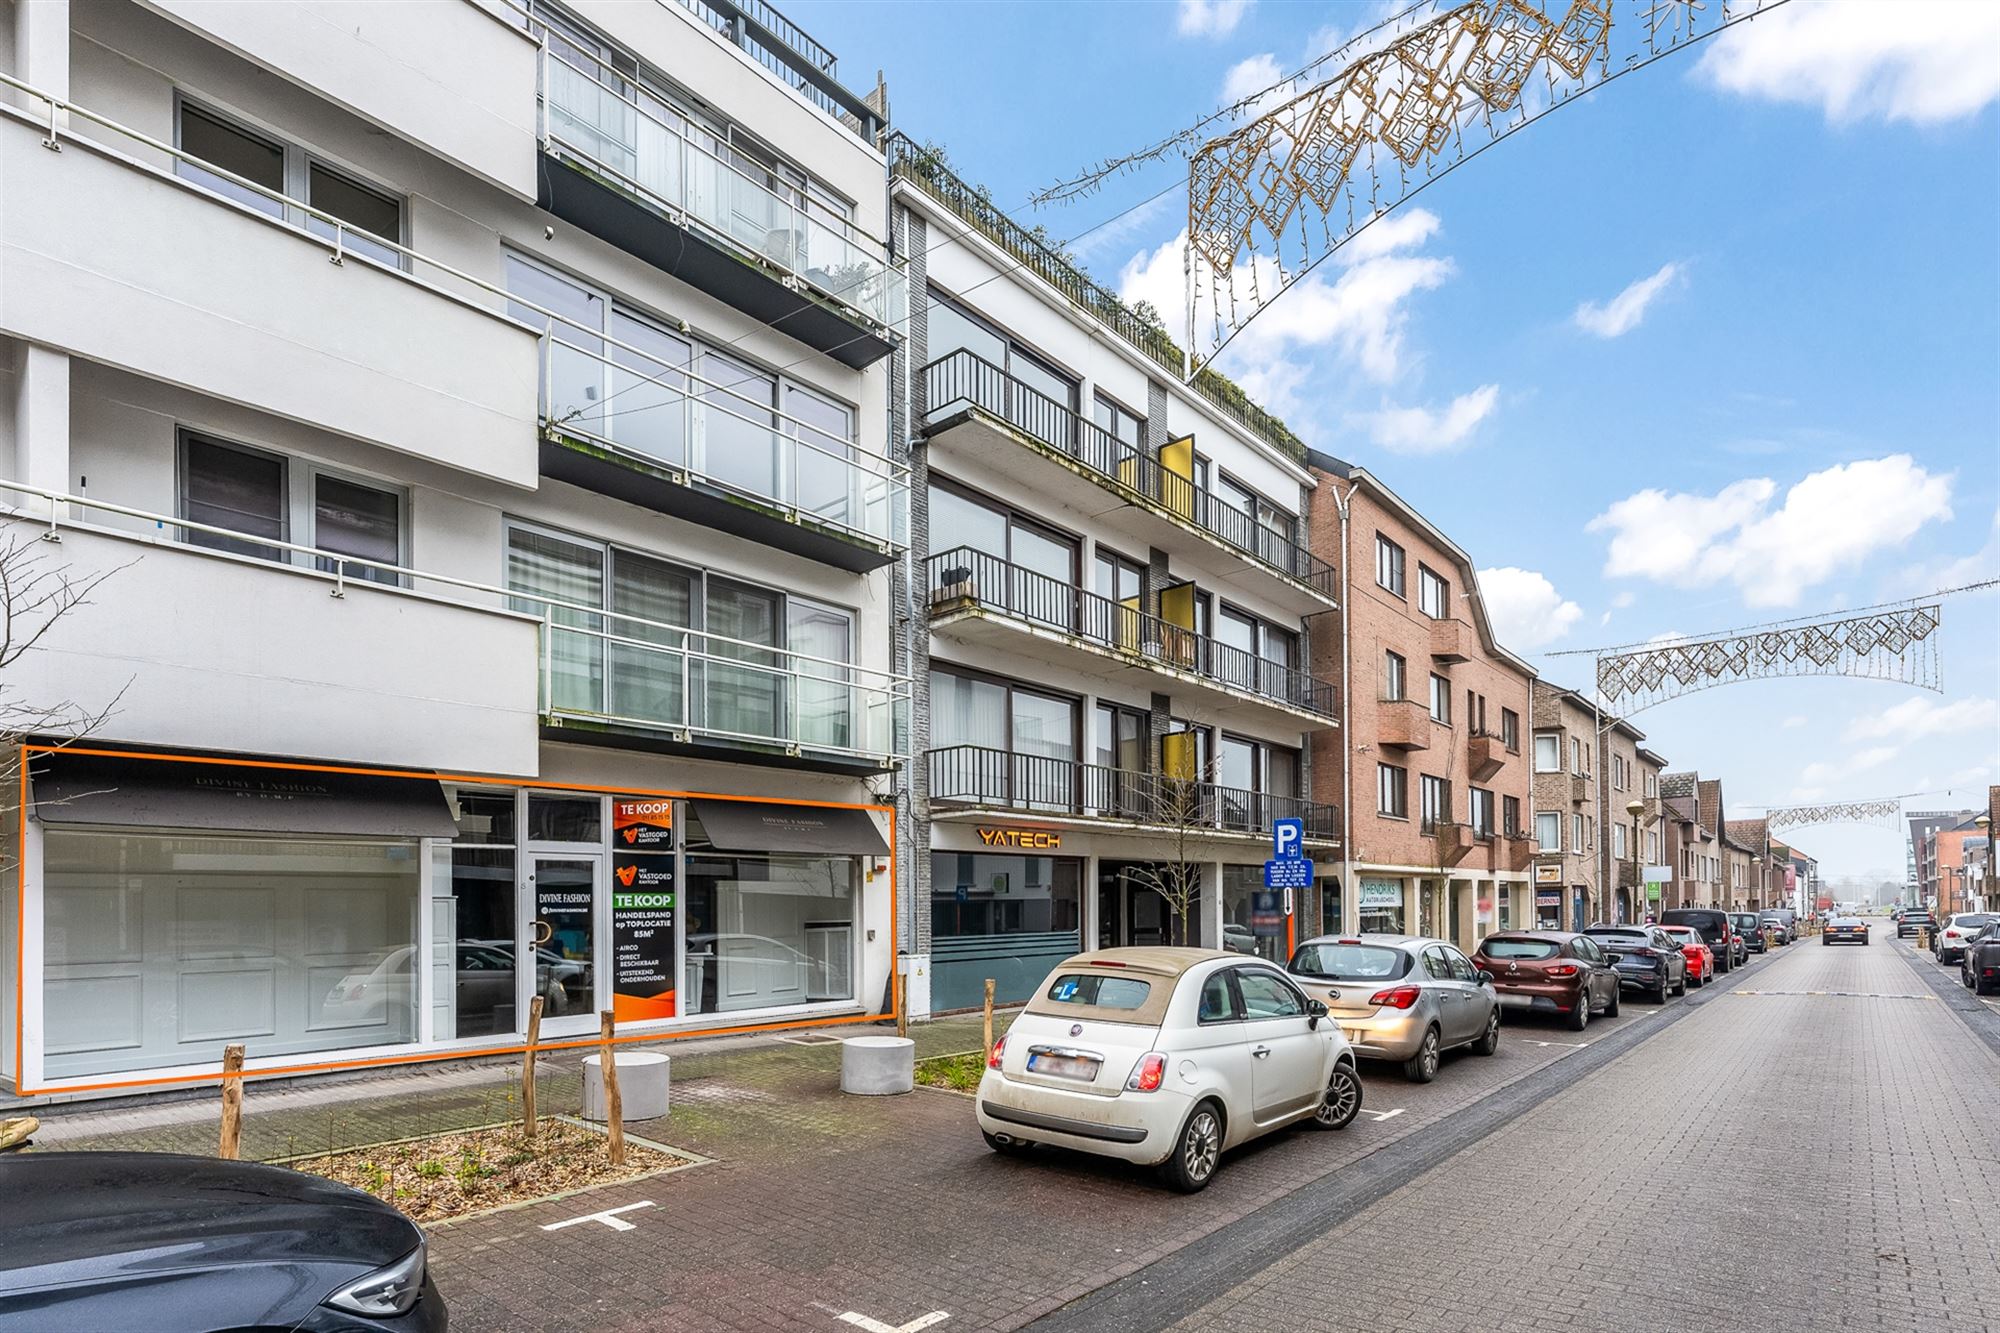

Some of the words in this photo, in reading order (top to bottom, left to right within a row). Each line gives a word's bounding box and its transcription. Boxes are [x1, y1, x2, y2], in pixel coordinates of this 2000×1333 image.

[621, 804, 634, 815] TE
[636, 803, 668, 814] KOOP
[977, 828, 1061, 849] YATECH
[1277, 824, 1298, 854] P
[1366, 883, 1396, 895] HENDRIKS
[539, 893, 562, 903] DIVINE
[563, 893, 591, 903] FASHION
[615, 896, 632, 906] TE
[634, 895, 671, 906] KOOP
[615, 911, 671, 919] HANDELSPAND
[625, 919, 671, 928] TOPLOCATIE
[619, 953, 640, 961] DIRECT
[620, 959, 660, 967] BESCHIKBAAR
[619, 969, 654, 977] UITSTEKEND
[619, 974, 666, 984] ONDERHOUDEN
